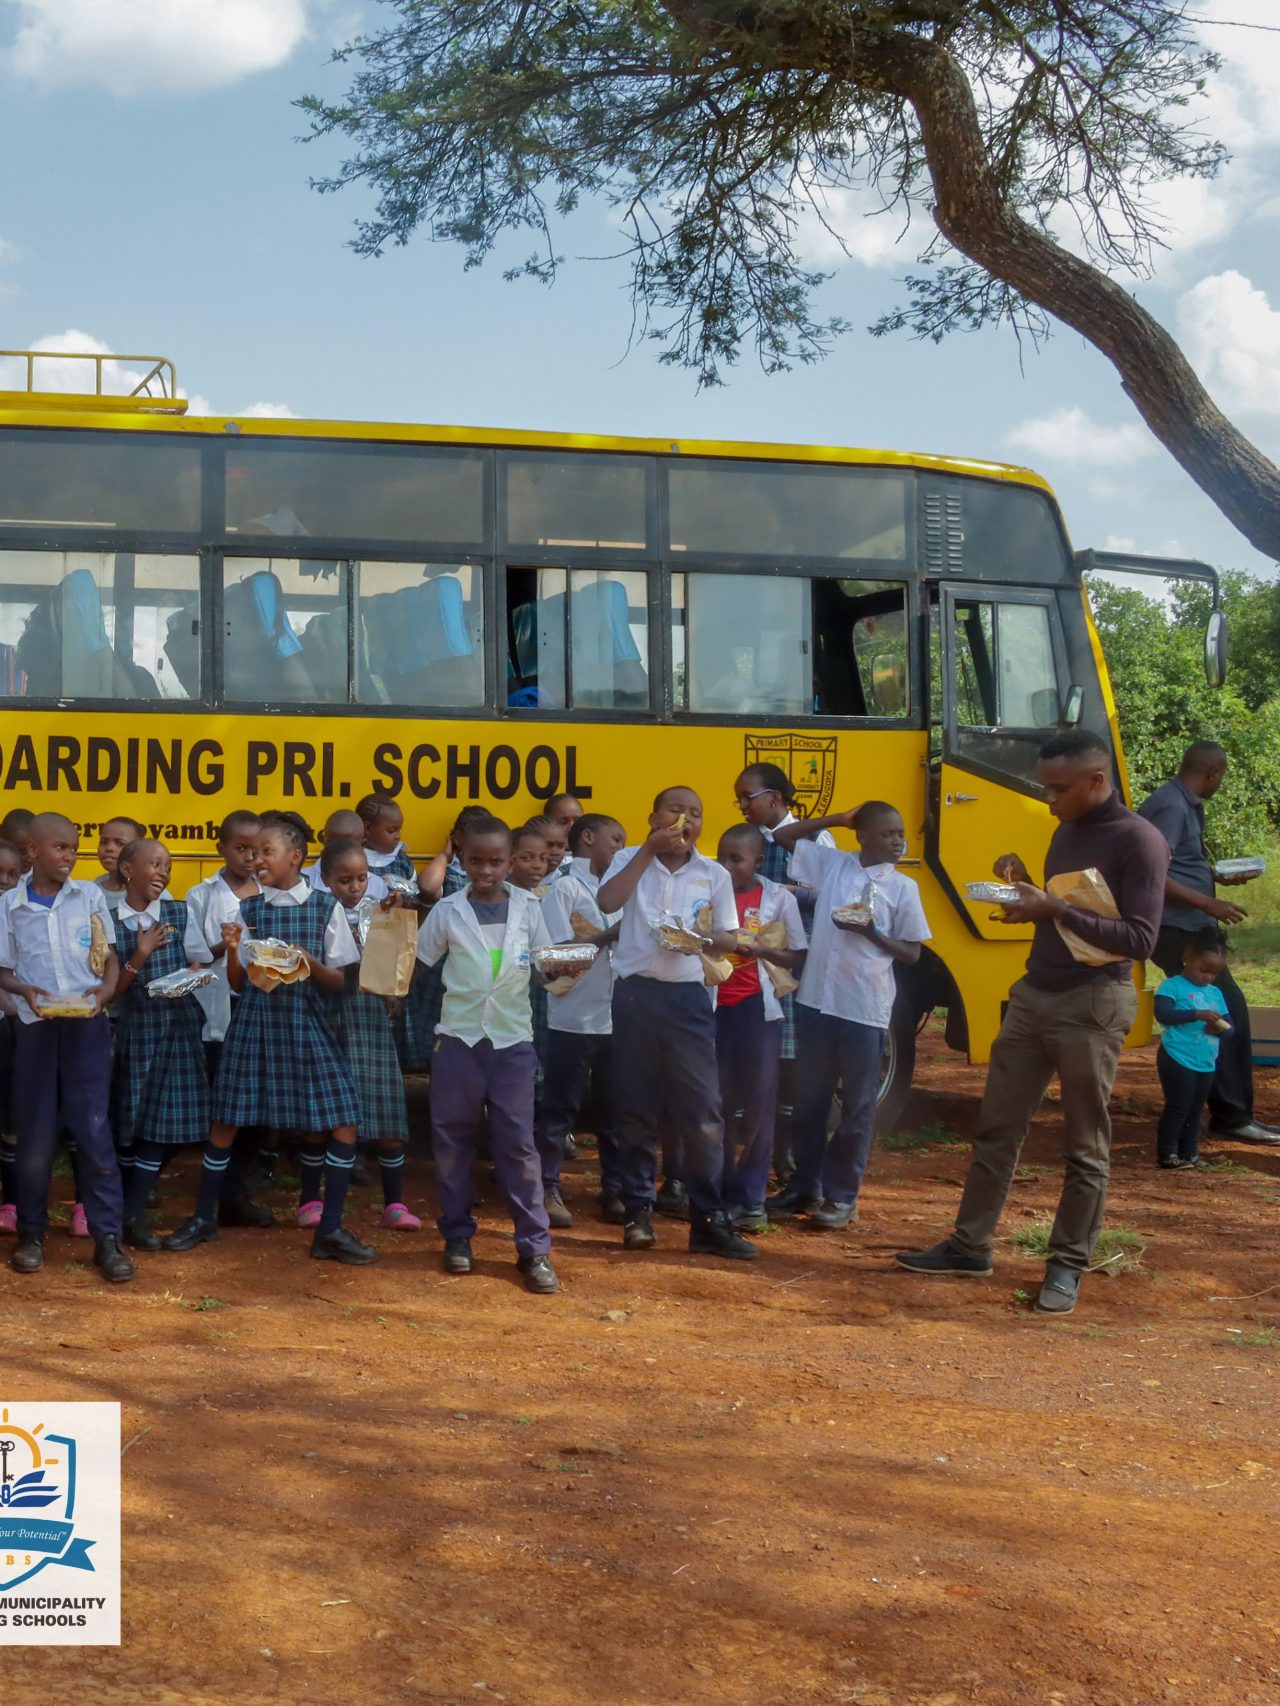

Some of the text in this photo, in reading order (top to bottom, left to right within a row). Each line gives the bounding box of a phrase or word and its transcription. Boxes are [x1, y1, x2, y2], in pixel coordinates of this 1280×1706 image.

[755, 738, 823, 749] PRIMARY SCHOOL
[246, 740, 351, 798] PRI.
[373, 743, 593, 801] SCHOOL
[816, 769, 833, 815] KERUGOYA
